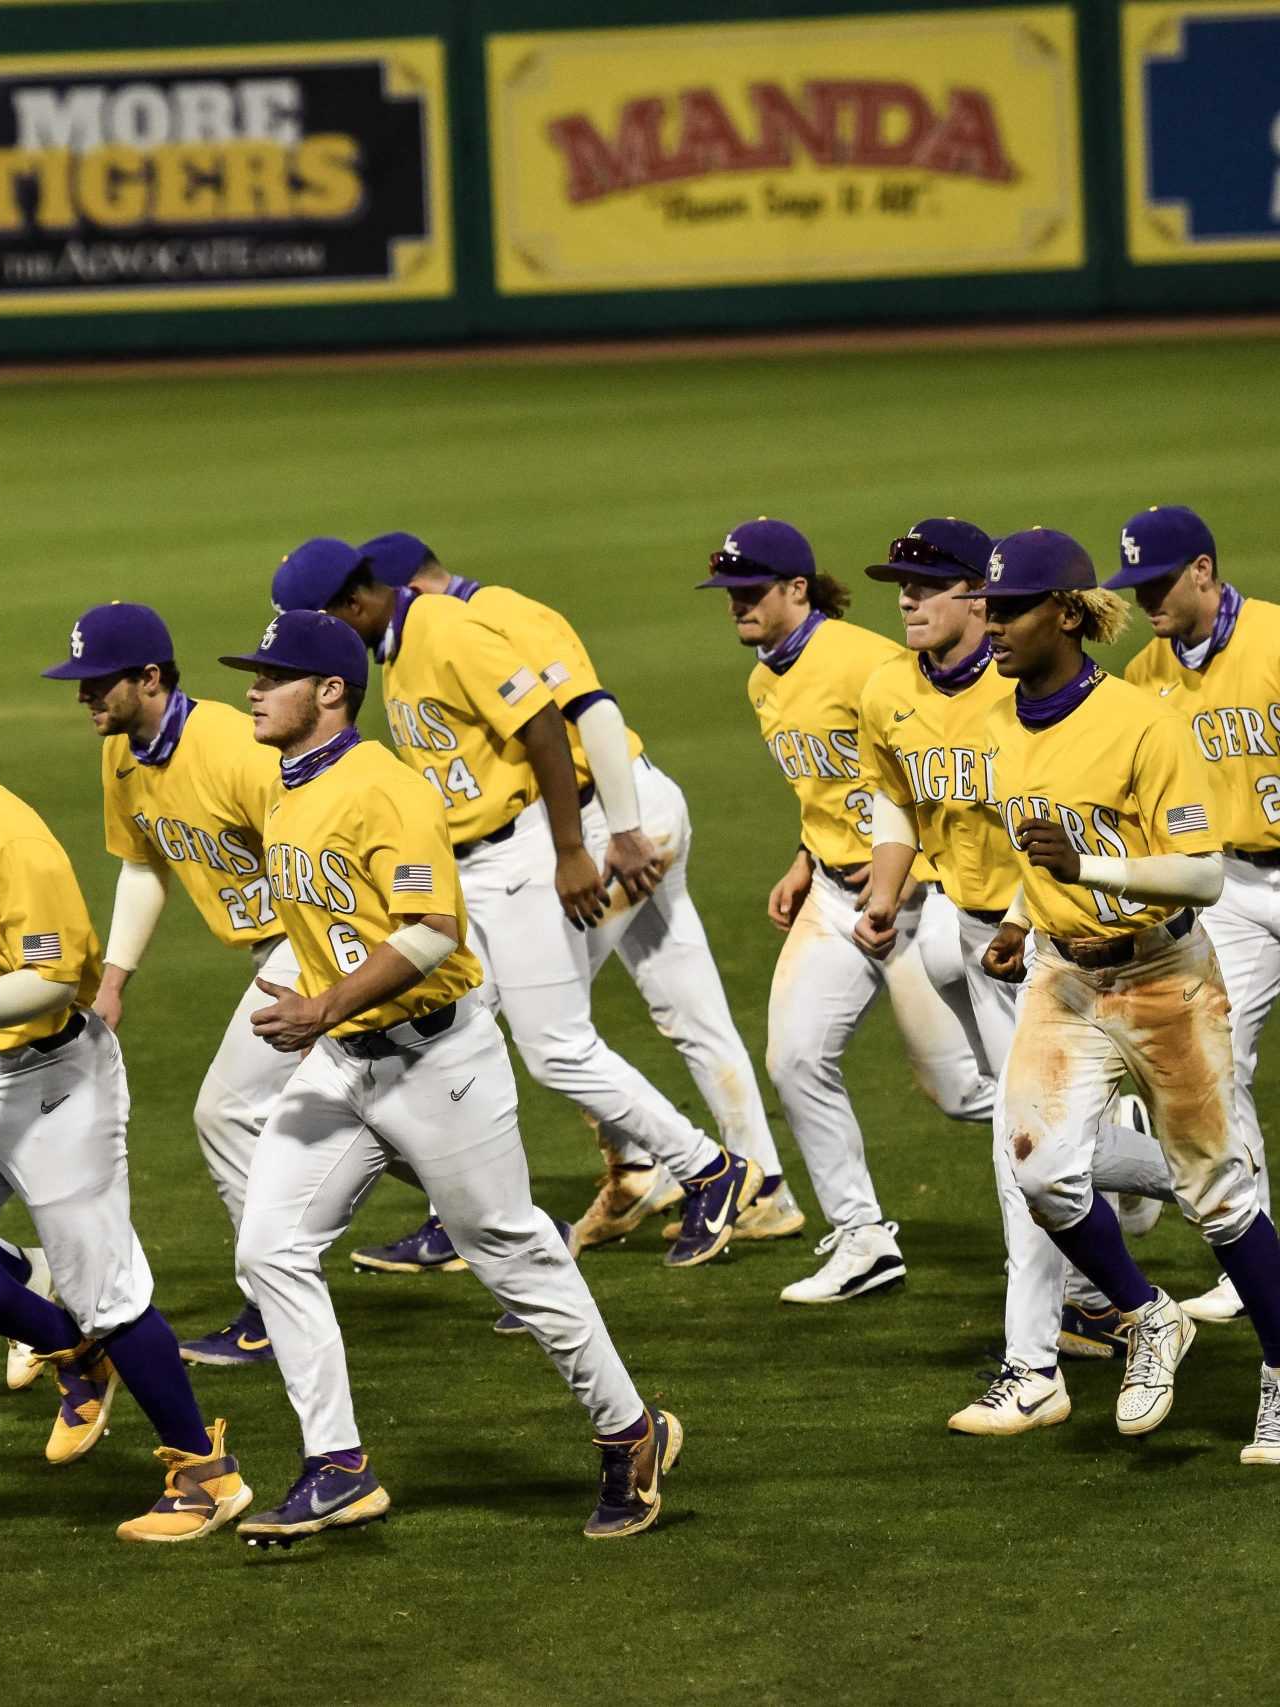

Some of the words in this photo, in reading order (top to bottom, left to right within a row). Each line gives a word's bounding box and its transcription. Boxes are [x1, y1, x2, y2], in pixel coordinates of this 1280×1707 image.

[12, 79, 302, 151] MORE
[546, 79, 1024, 208] MANDA
[1121, 528, 1140, 564] LSU
[422, 756, 482, 810] 14
[219, 874, 278, 930] 27
[267, 843, 357, 915] GERS
[326, 921, 369, 975] 6
